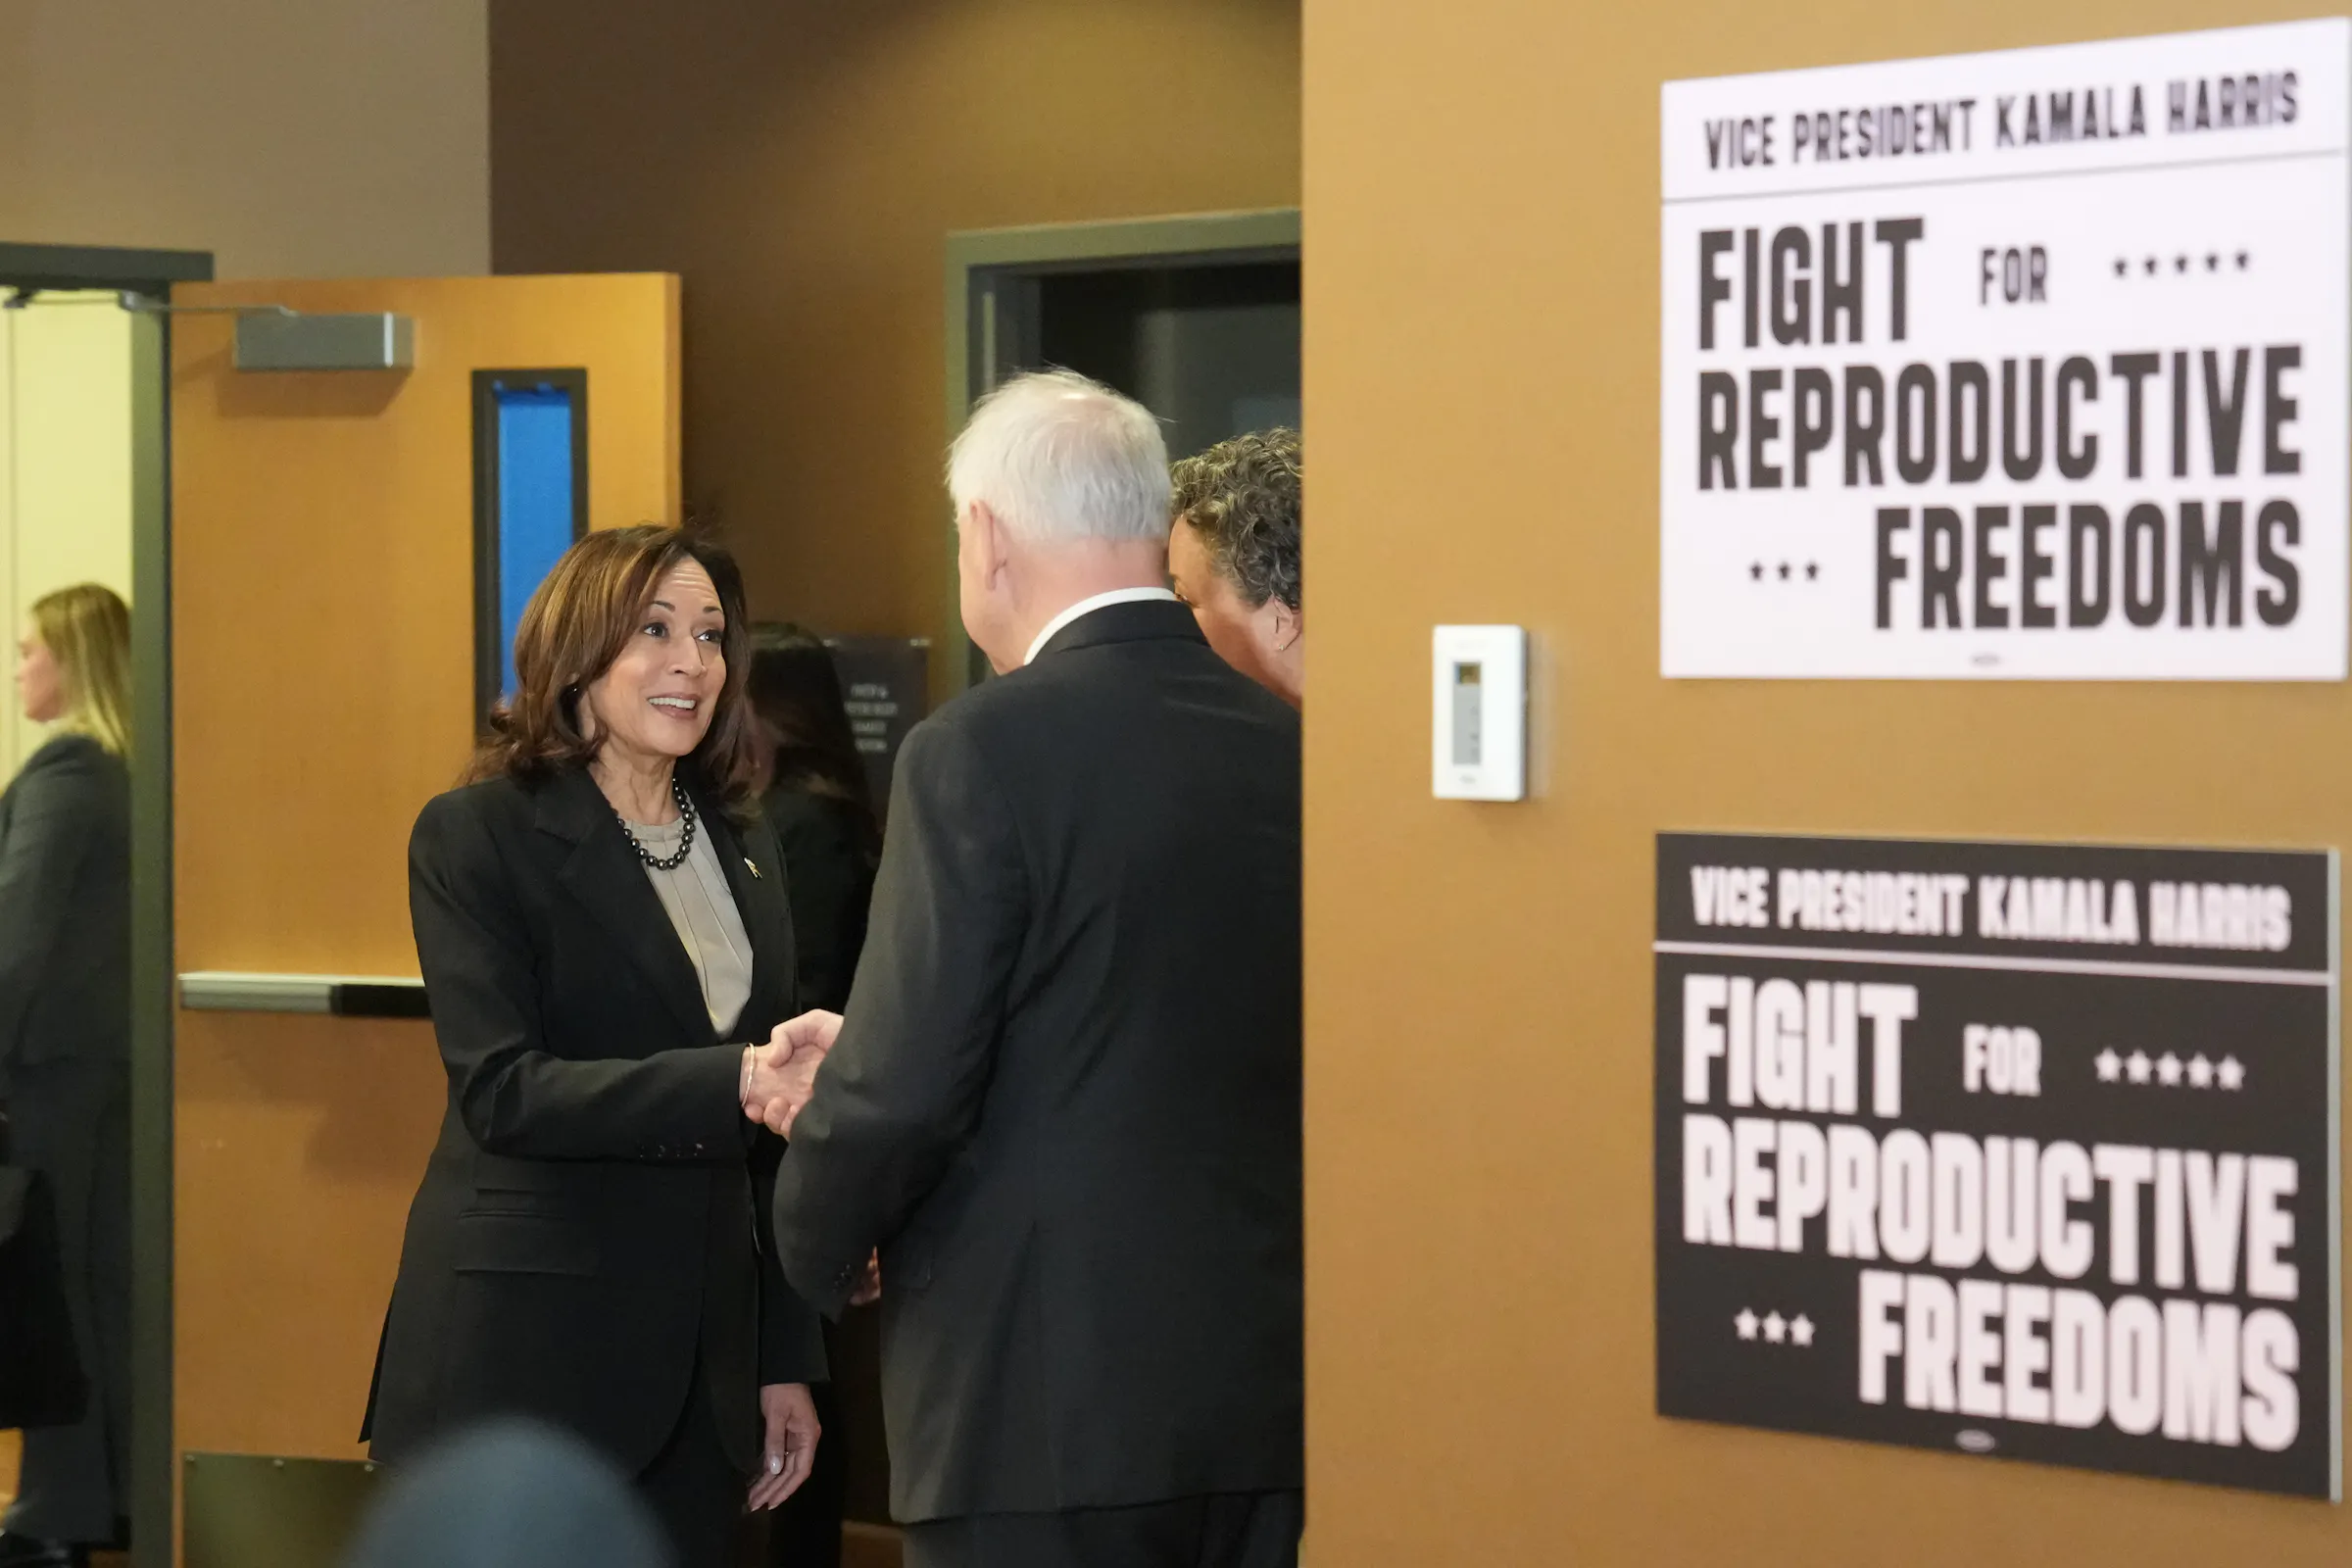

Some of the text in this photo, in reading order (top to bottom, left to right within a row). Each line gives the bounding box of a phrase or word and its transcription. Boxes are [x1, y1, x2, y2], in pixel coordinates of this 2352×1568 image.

[1704, 71, 2300, 171] VICE PRESIDENT KAMALA HARRIS
[1699, 217, 2048, 351] FIGHT FOR
[1698, 344, 2302, 491] REPRODUCTIVE
[1876, 499, 2301, 630] FREEDOMS
[1690, 865, 2291, 952] VICE PRESIDENT KAMALA HARRIS
[1683, 974, 2041, 1117] FIGHT FOR
[1683, 1113, 2298, 1299] REPRODUCTIVE
[1859, 1269, 2299, 1450] FREEDOMS
